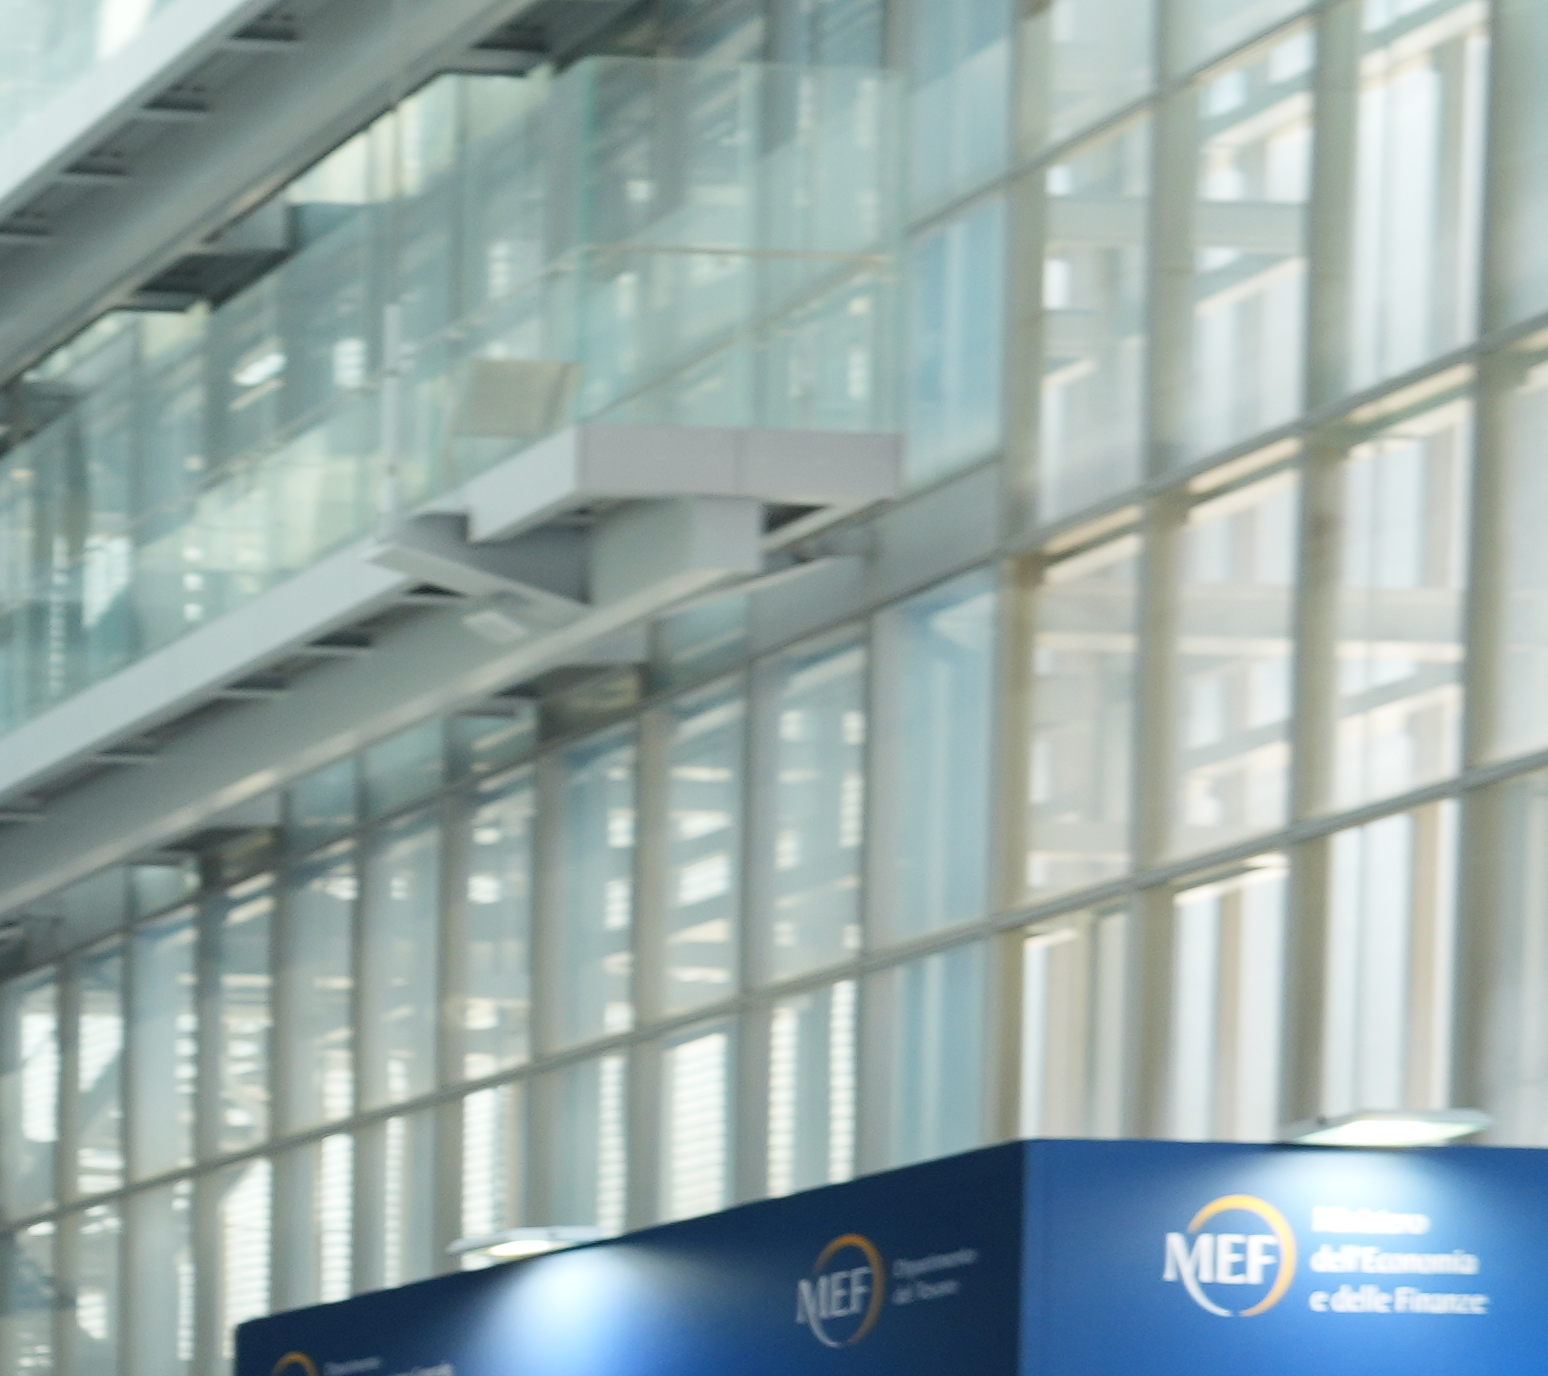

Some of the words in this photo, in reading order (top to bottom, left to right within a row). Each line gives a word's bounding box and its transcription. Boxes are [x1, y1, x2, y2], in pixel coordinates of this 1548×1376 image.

[1163, 1232, 1278, 1284] MEF
[796, 1266, 872, 1324] MEF
[1309, 1291, 1329, 1312] e
[1330, 1284, 1392, 1314] delle
[1395, 1286, 1490, 1314] Finanze
